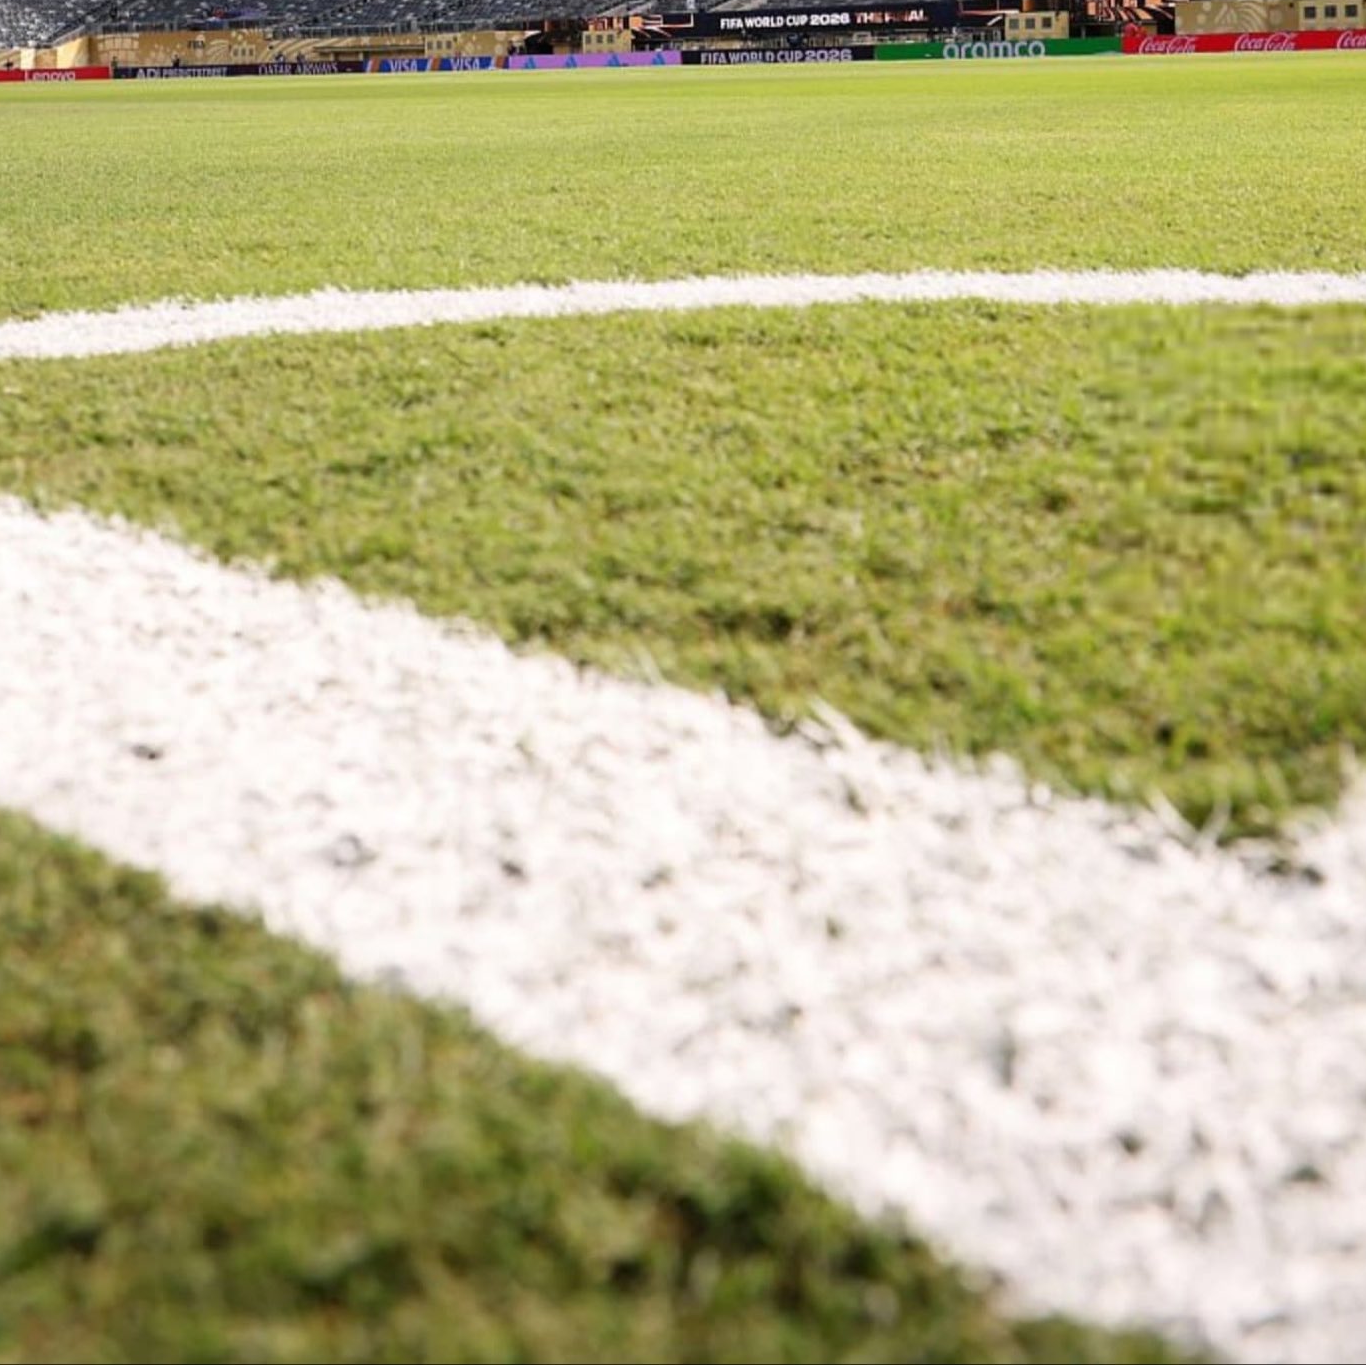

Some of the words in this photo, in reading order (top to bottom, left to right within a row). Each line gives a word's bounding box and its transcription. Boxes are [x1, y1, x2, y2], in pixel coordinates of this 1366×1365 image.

[720, 16, 743, 29] FIFA
[745, 15, 784, 29] WORLD
[785, 14, 808, 26] CUP
[810, 13, 851, 26] 2026
[854, 11, 883, 24] THE
[884, 10, 928, 23] FNAL
[700, 51, 726, 64] FIFA
[728, 50, 775, 63] WORLD
[777, 49, 804, 63] CUP
[804, 48, 853, 61] 2026
[943, 41, 1045, 59] aramco
[258, 63, 292, 76] QATAR
[390, 59, 418, 71] VISA
[451, 57, 480, 70] VISA
[24, 69, 76, 81] Lenovo
